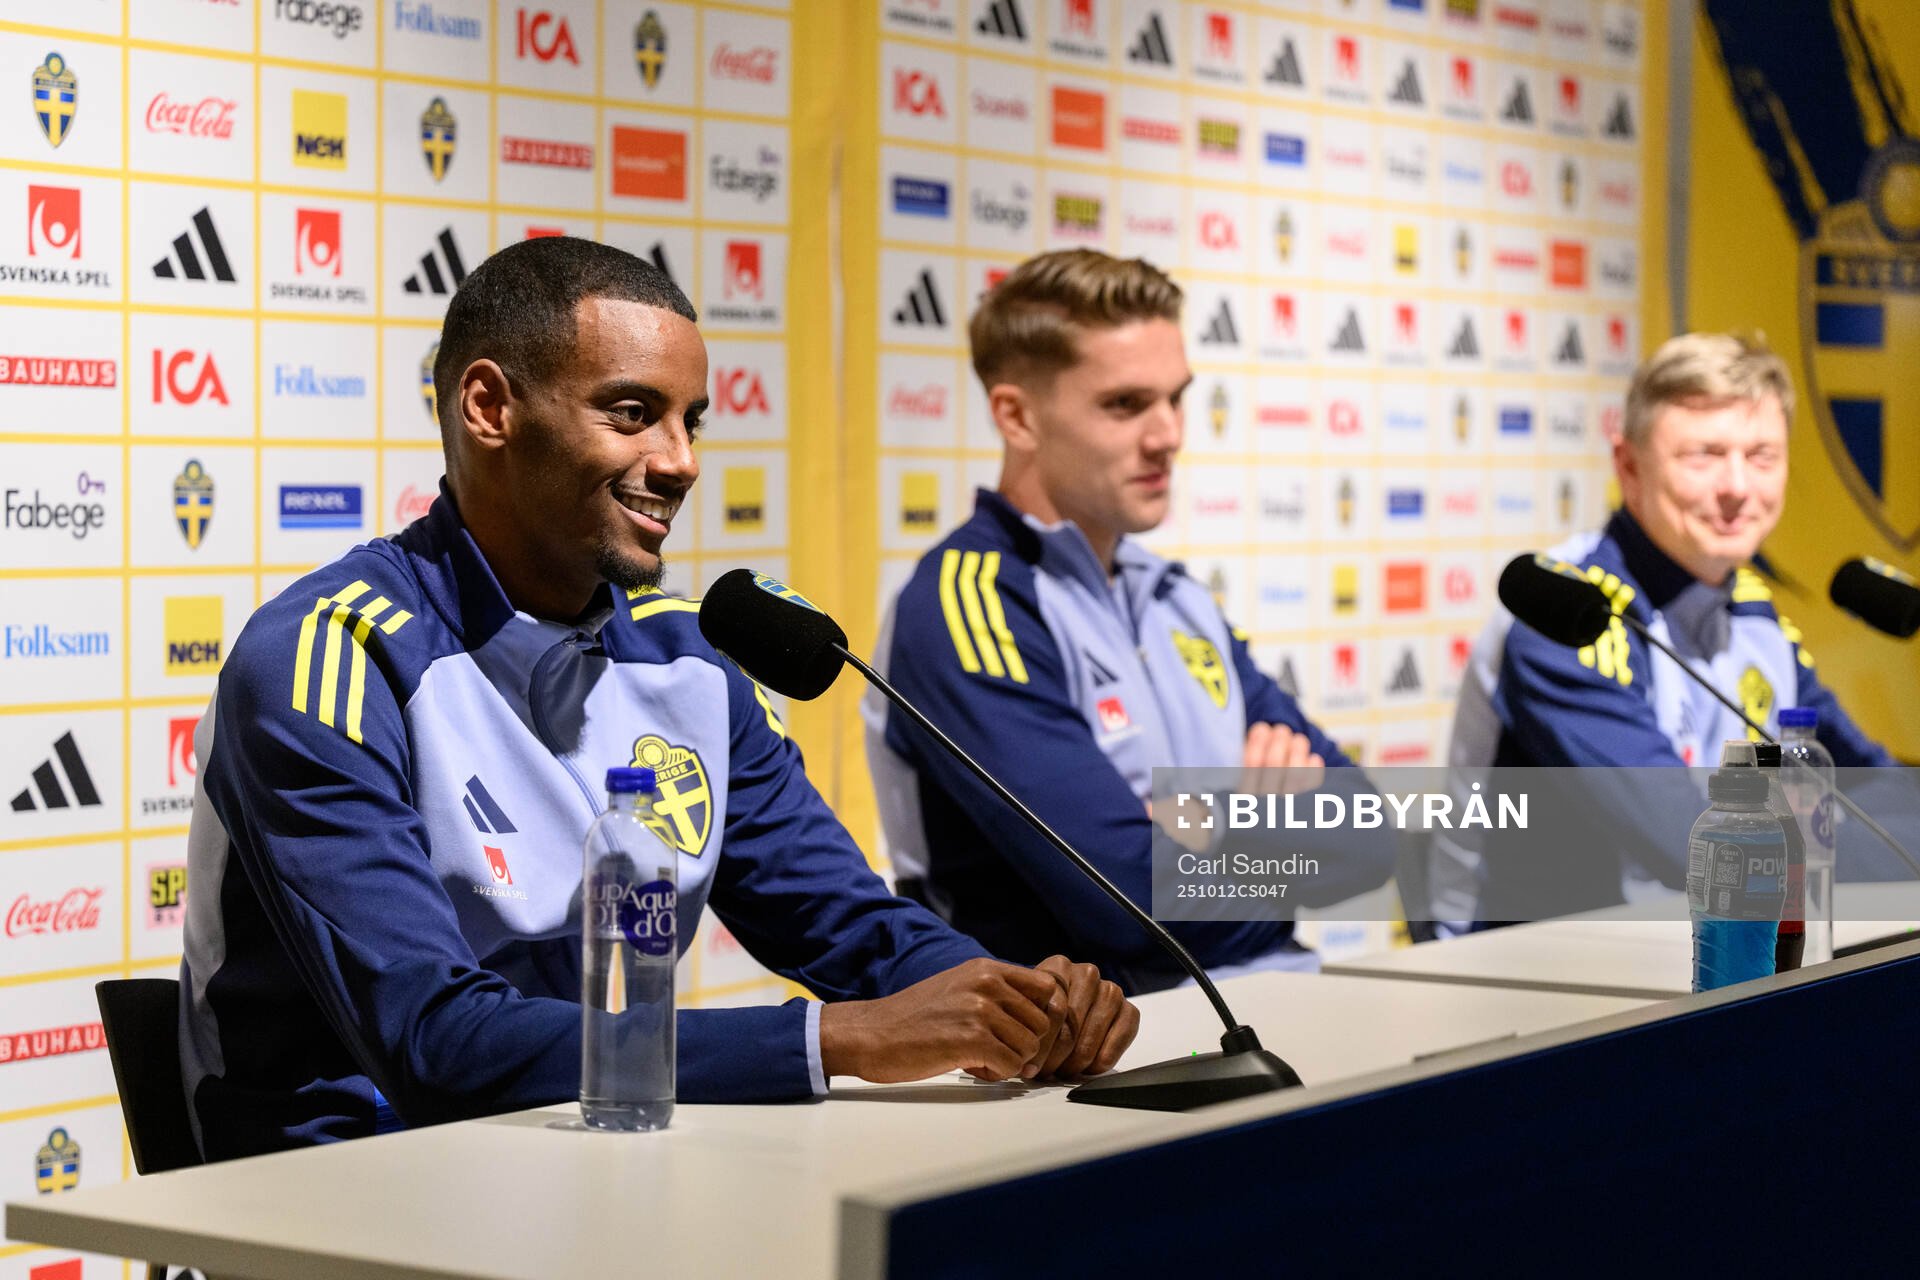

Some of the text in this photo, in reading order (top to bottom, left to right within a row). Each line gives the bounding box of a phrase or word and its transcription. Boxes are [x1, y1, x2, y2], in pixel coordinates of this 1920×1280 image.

[516, 8, 580, 66] ICA
[0, 266, 111, 288] SVENSKA SPEL
[152, 348, 230, 405] ICA
[274, 364, 366, 397] Folksam
[716, 368, 770, 415] ICA
[5, 489, 105, 539] Fabege
[4, 624, 109, 658] Folksam
